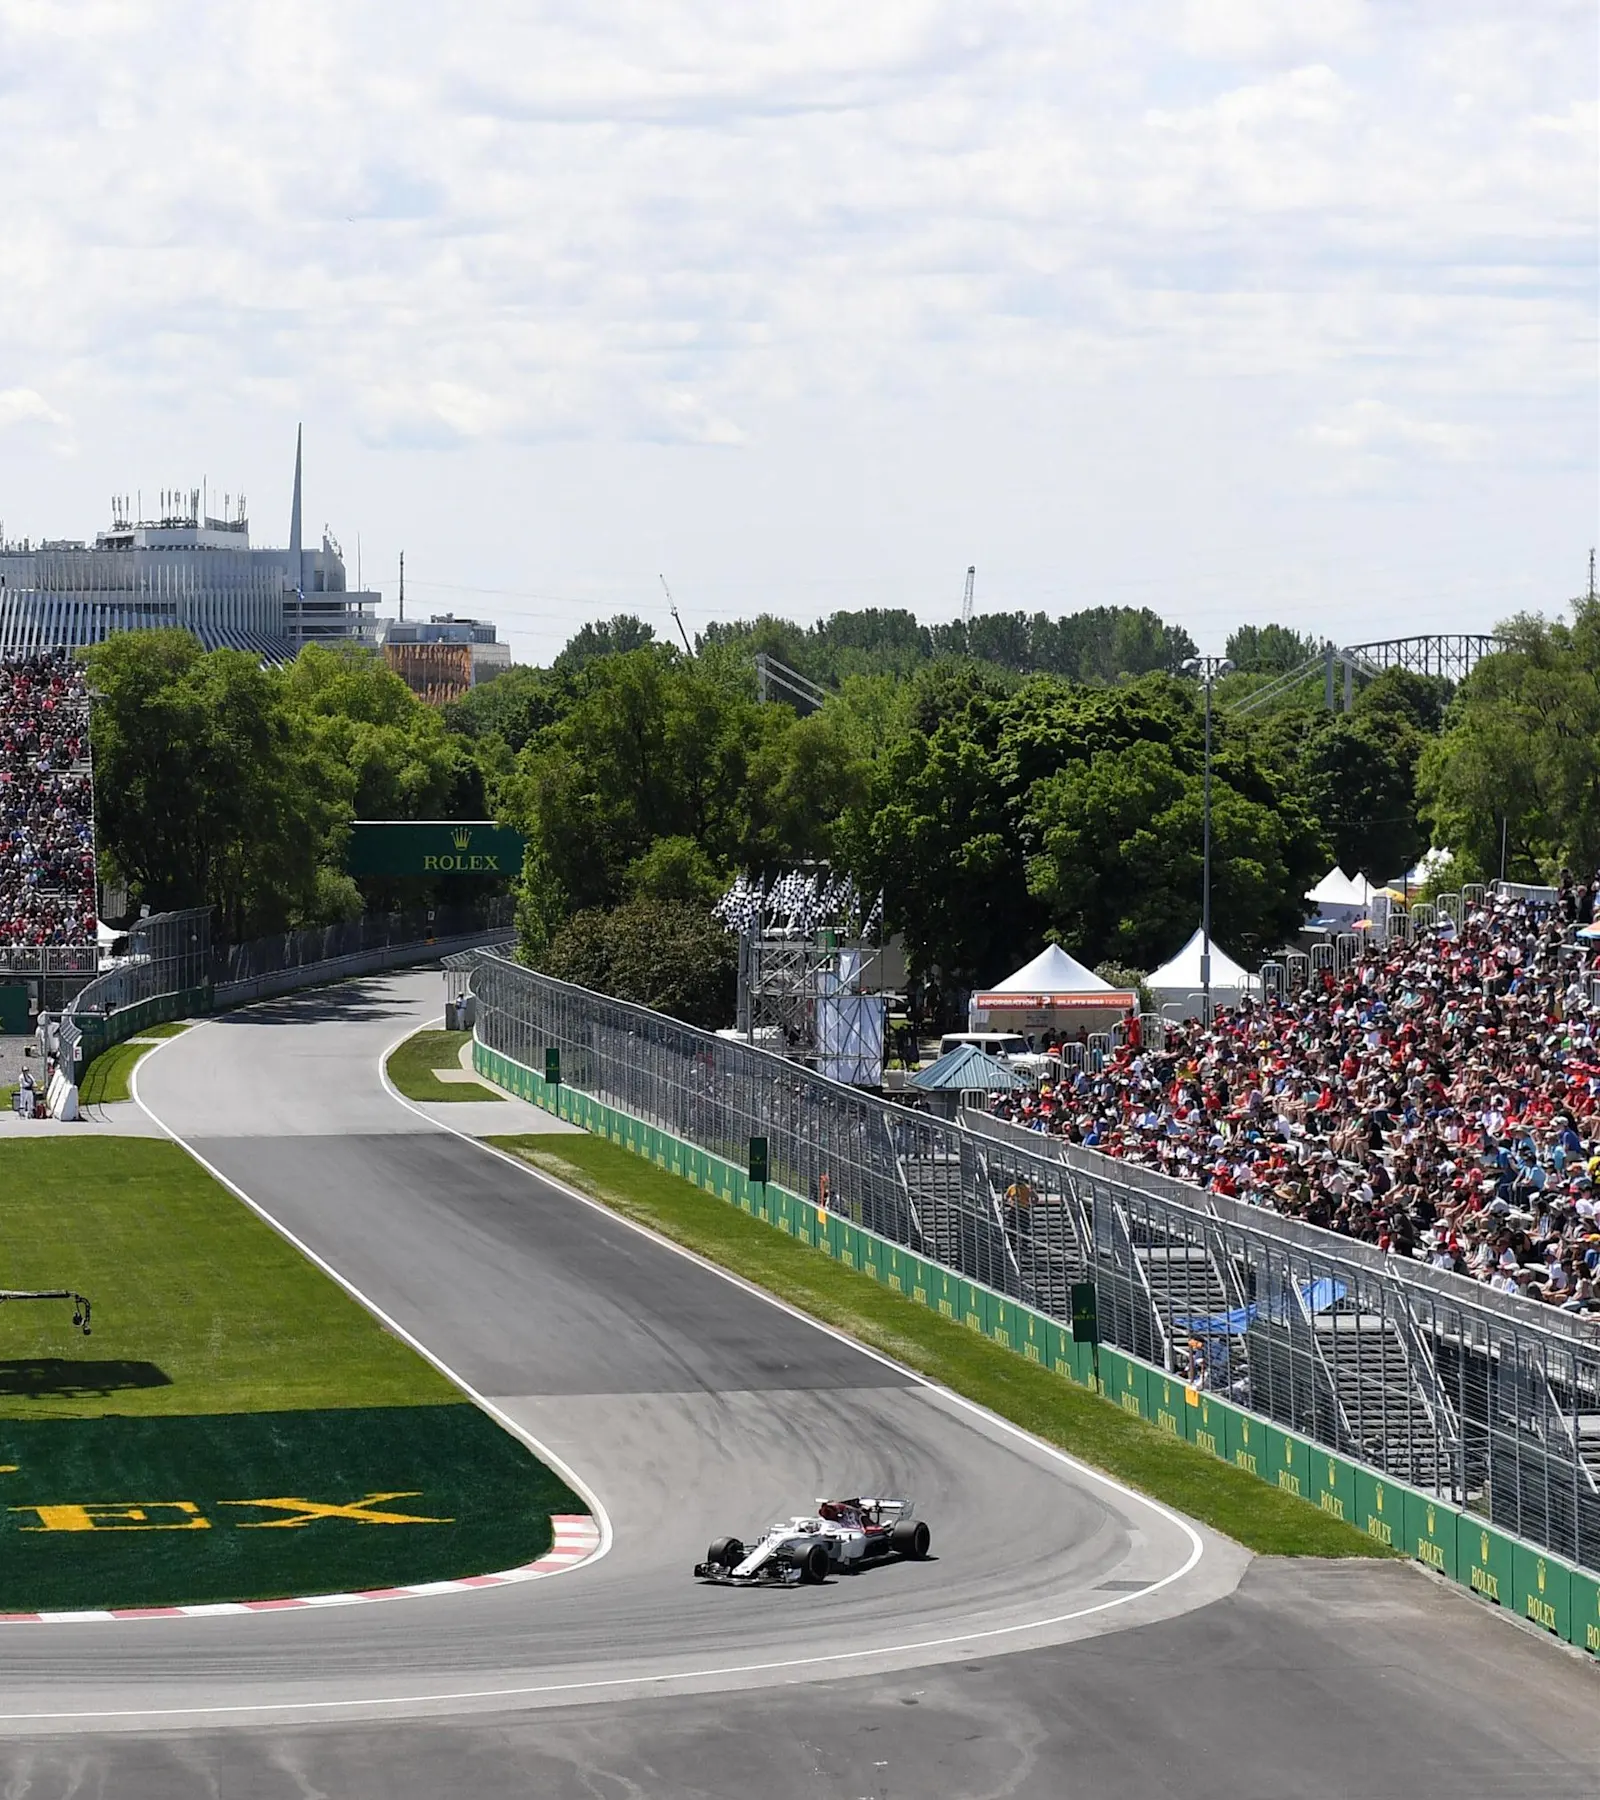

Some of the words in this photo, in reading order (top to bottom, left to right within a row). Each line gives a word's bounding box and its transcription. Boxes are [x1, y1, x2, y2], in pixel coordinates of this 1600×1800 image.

[423, 855, 499, 871] ROLEX
[74, 1049, 80, 1059] F
[1278, 1468, 1300, 1496] ROLEX
[1320, 1489, 1344, 1521] ROLEX
[1367, 1513, 1392, 1545] ROLEX
[1418, 1537, 1444, 1570] ROLEX
[1471, 1564, 1499, 1601] ROLEX
[1527, 1593, 1556, 1631] ROLEX
